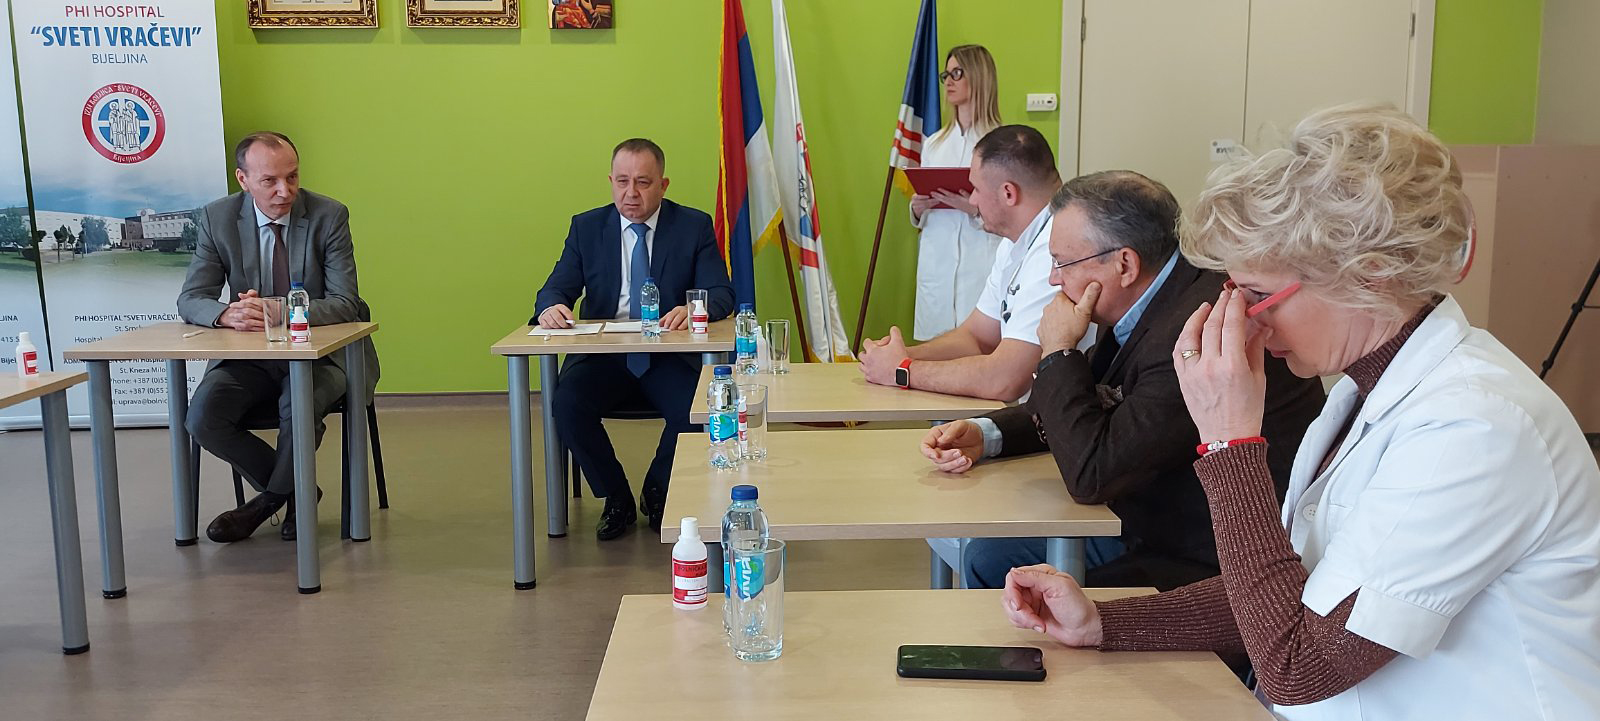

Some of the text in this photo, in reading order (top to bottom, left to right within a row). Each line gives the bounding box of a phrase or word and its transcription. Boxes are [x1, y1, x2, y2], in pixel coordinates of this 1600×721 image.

[65, 5, 165, 18] PHI HOSPITAL
[92, 53, 148, 64] BIJELJINA
